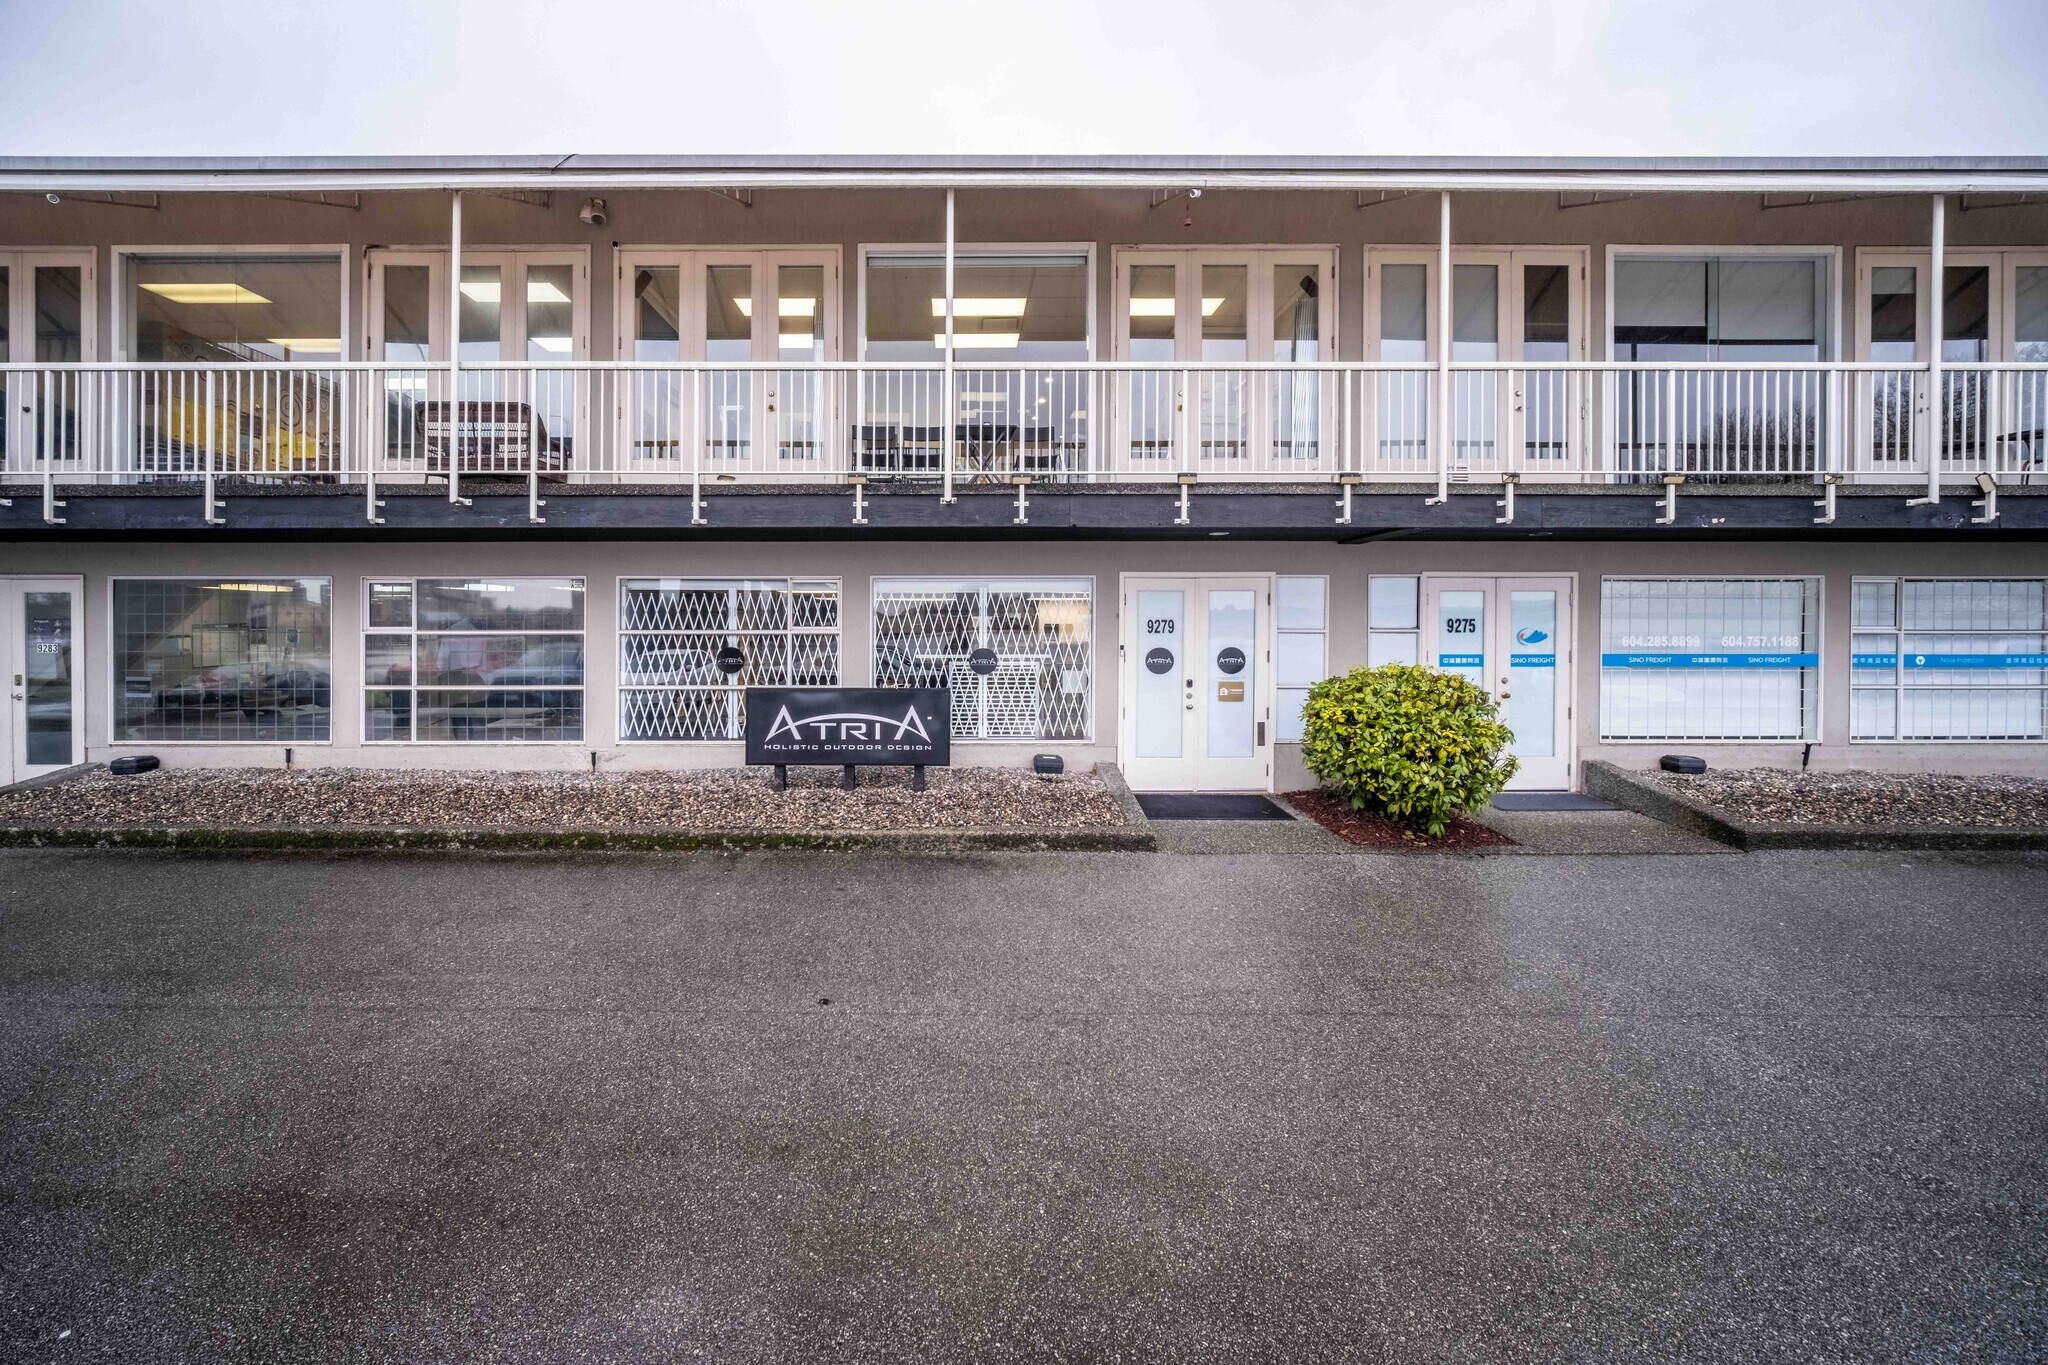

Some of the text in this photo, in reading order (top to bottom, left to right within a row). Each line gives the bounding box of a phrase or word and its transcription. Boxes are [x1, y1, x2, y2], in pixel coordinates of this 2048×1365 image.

[1147, 619, 1175, 634] 9279
[1447, 618, 1476, 633] 9275
[37, 644, 58, 653] 9283
[1622, 636, 1800, 648] 604.285.8899 604.757.1188
[1146, 657, 1173, 665] ATRIA
[765, 704, 932, 743] ATRIA
